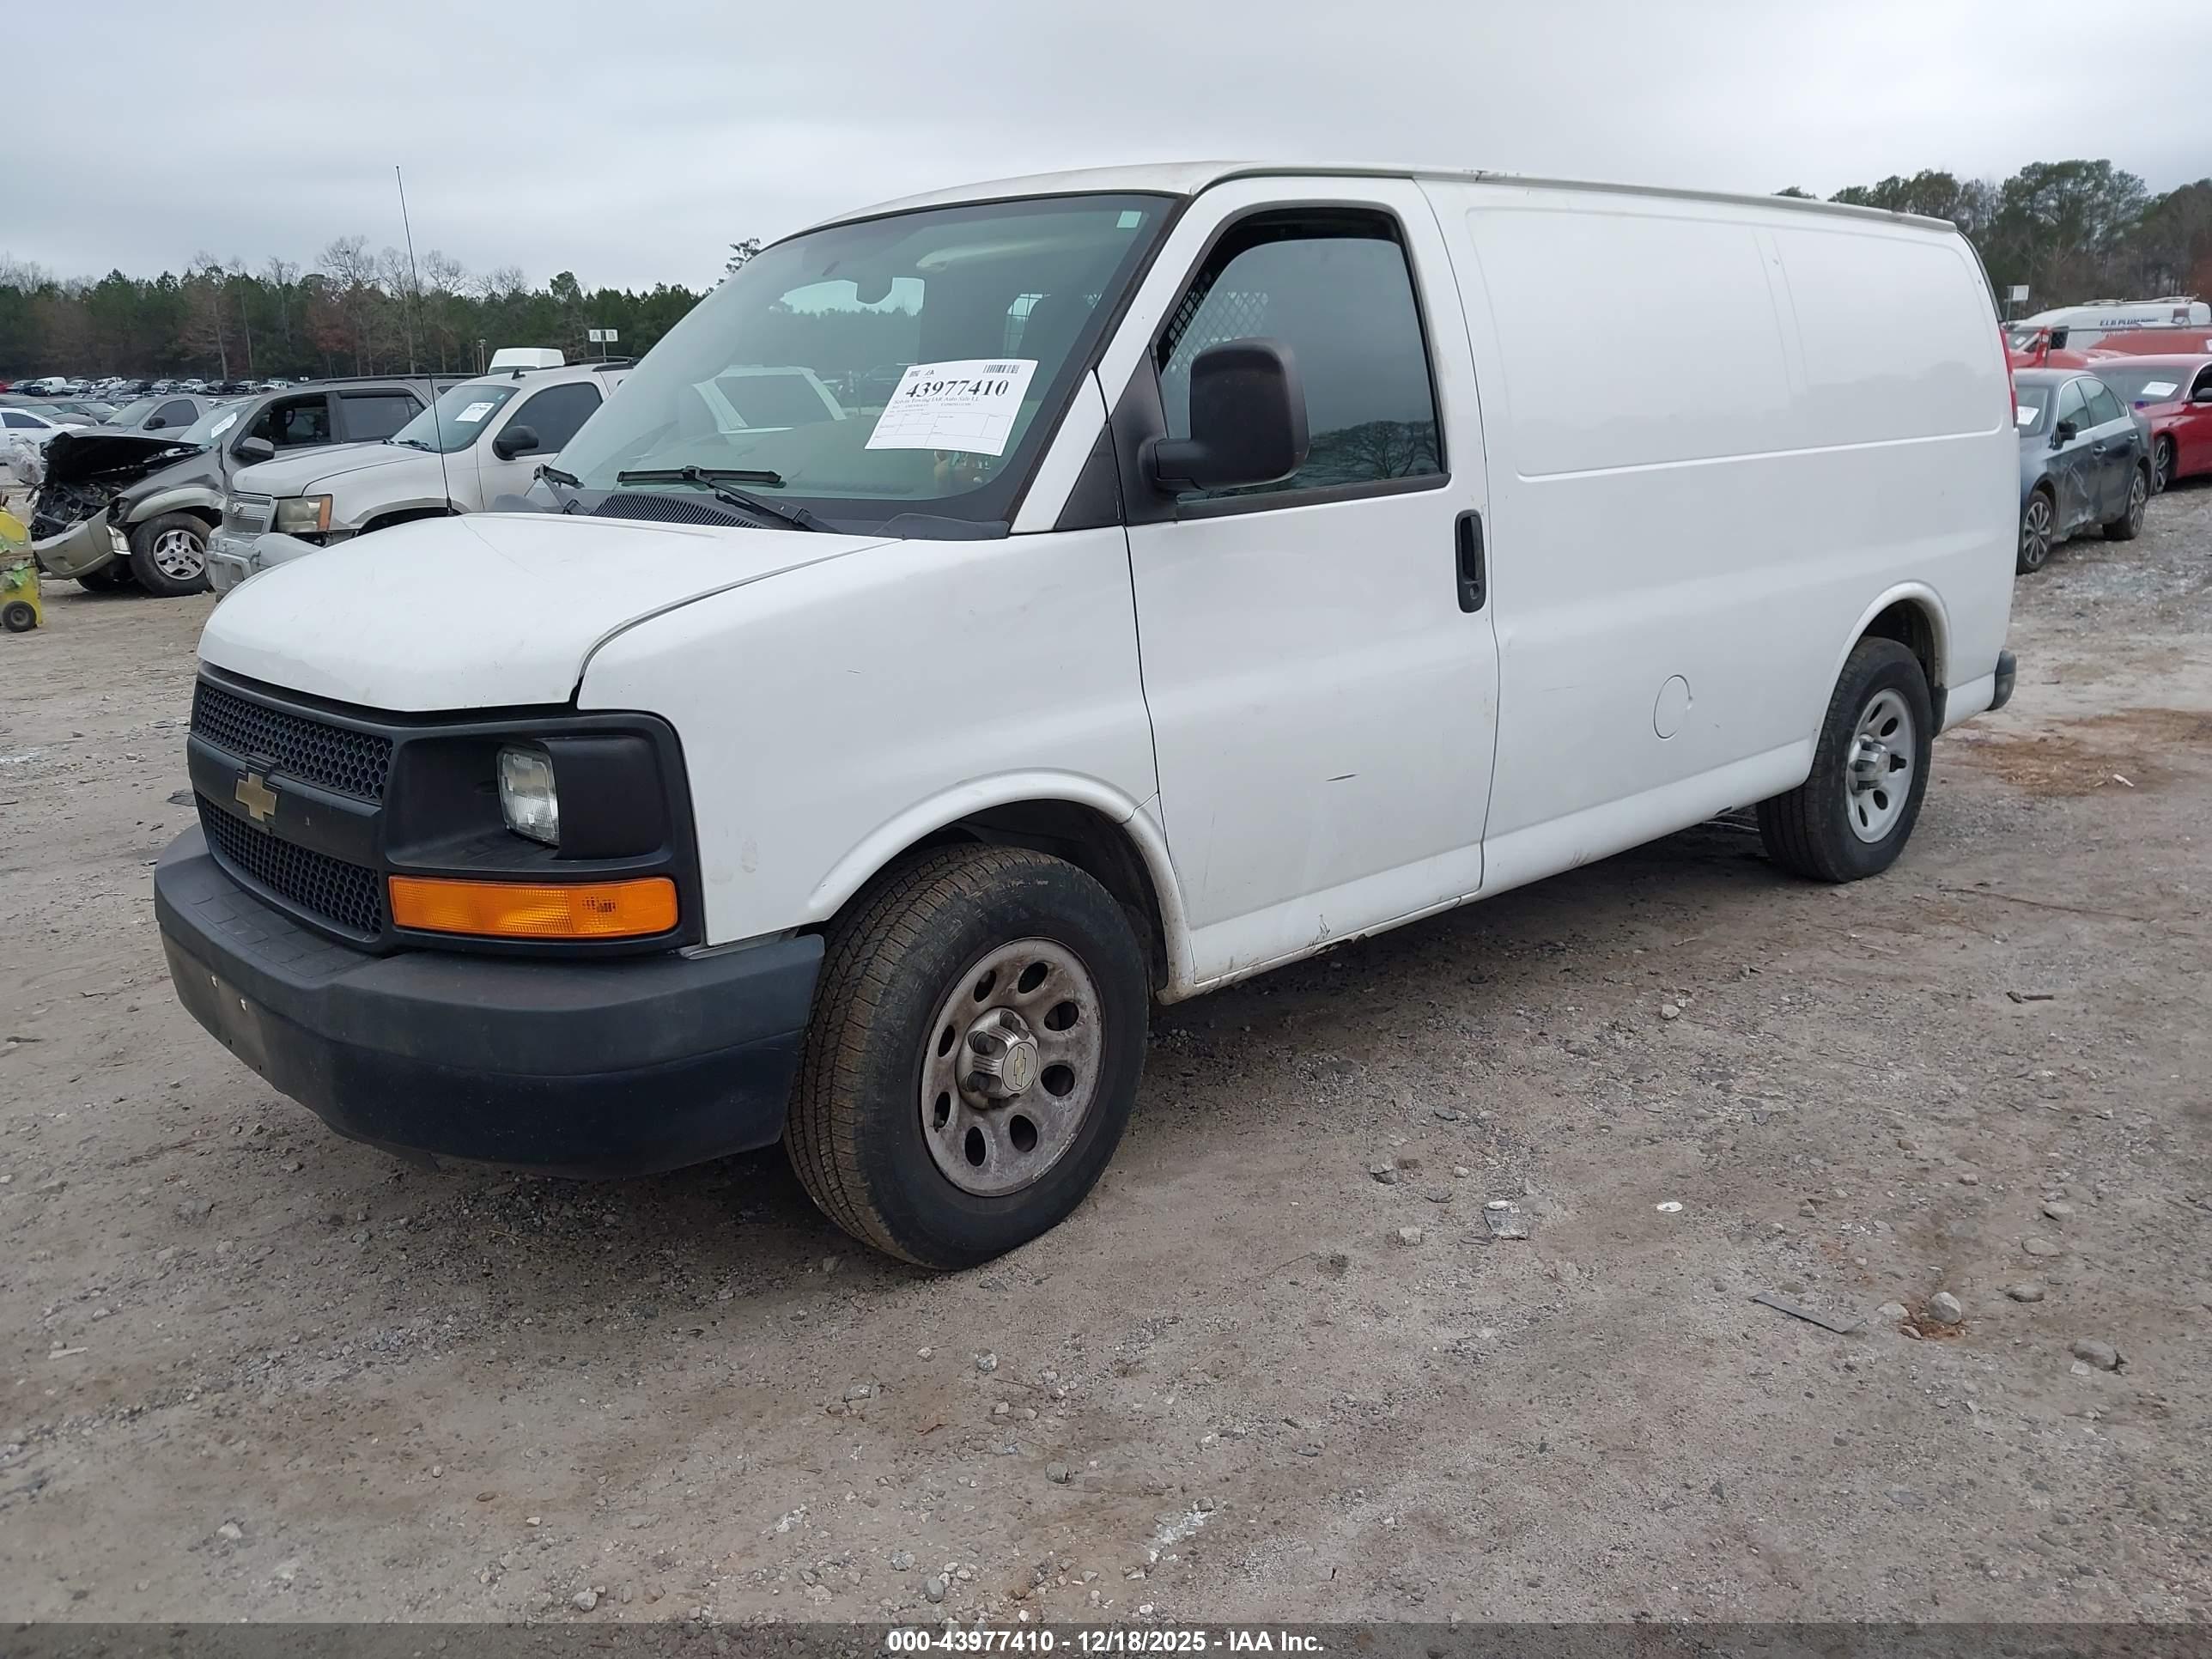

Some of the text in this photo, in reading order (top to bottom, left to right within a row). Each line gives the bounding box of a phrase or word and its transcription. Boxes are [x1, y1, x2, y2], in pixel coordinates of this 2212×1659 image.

[591, 331, 599, 340] A
[608, 331, 616, 340] B
[906, 380, 1010, 398] 43977410
